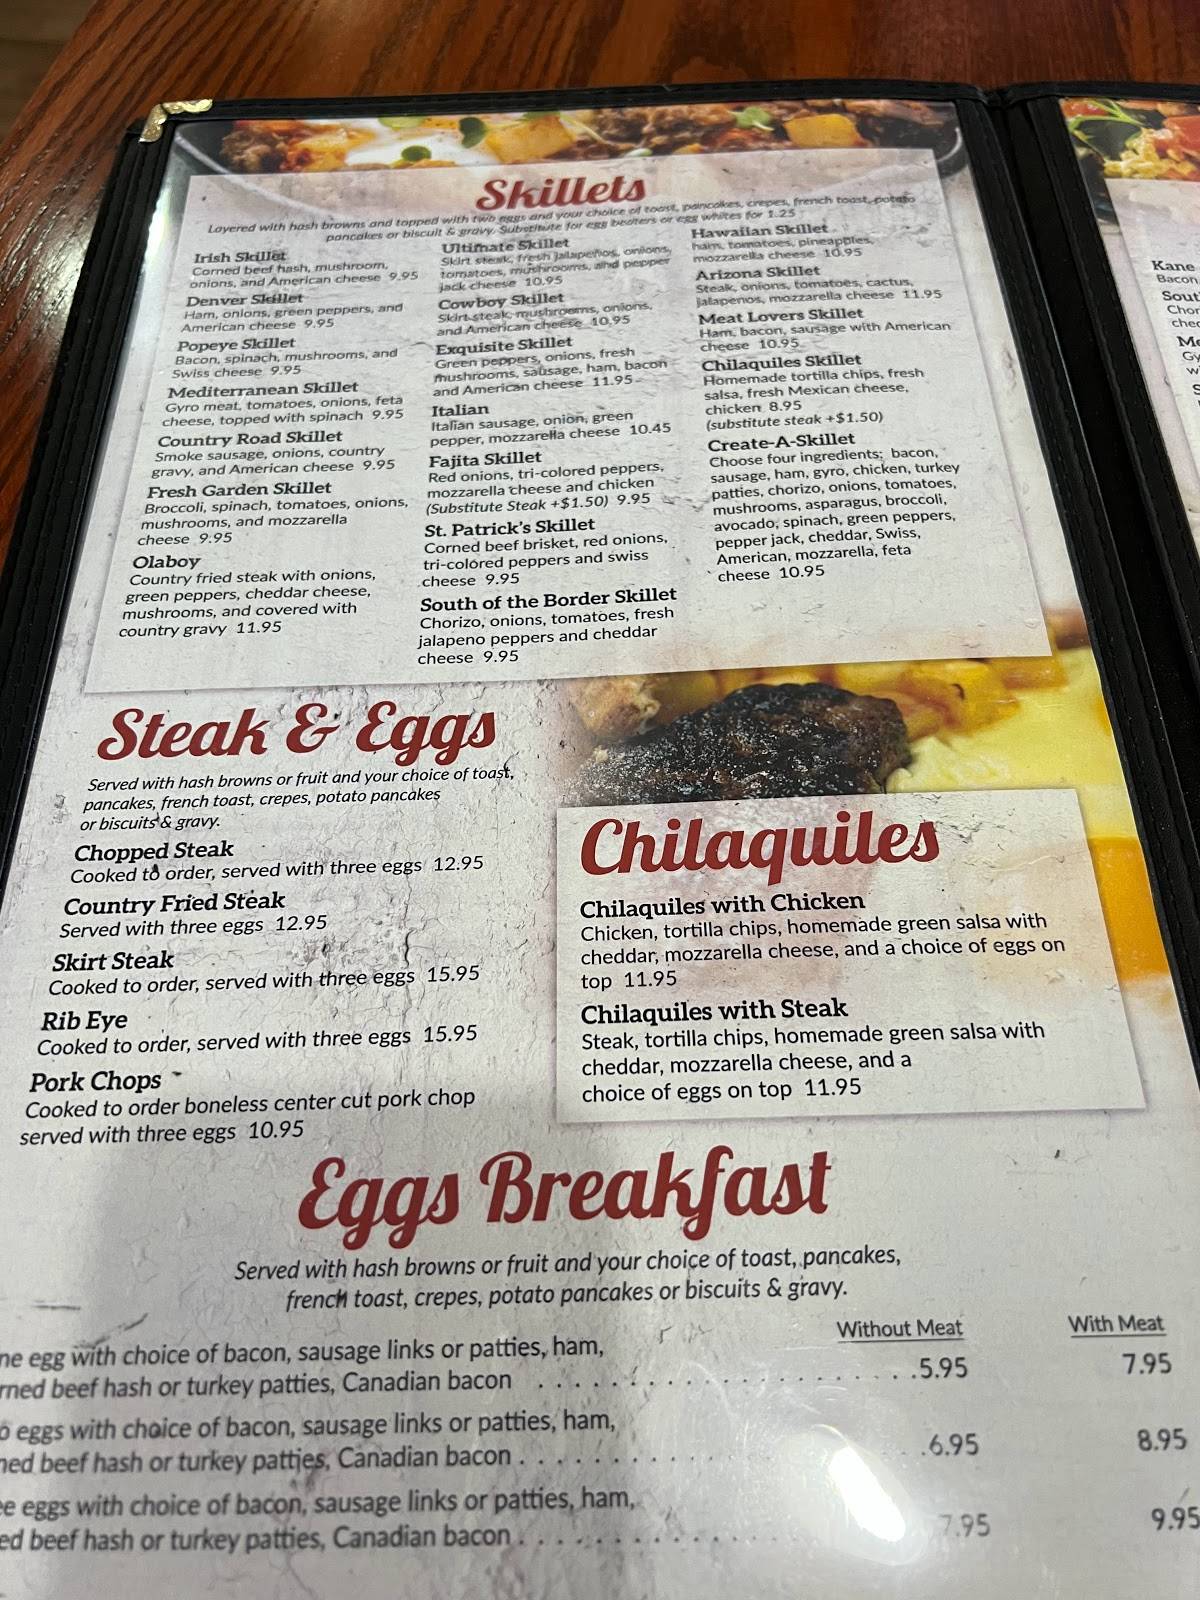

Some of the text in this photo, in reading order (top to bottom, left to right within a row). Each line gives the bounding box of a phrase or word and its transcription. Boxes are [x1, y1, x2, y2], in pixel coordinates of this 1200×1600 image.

[477, 176, 644, 210] Skillets
[691, 223, 828, 238] Hawaiian Skillet
[441, 238, 569, 253] Ultimate Skillet
[194, 250, 287, 263] Irish Skillet
[1151, 260, 1195, 271] Kane
[695, 265, 820, 281] Arizona Skillet
[185, 292, 304, 307] Denver Skillet
[437, 292, 564, 310] Cowboy Skillet
[180, 317, 334, 332] American cheese 9.95
[698, 307, 863, 325] Meat Lovers Skillet
[176, 337, 296, 353] Popeye Skillet
[435, 336, 572, 356] Exquisite Skillet
[174, 347, 398, 365] Bacon, spinach, mushrooms, and
[434, 347, 635, 369] Green peppers, onions, fresh
[701, 353, 861, 371] Chilaquiles Skillet
[171, 364, 301, 378] Swiss cheese 9.95
[167, 381, 359, 398] Mediterranean Skillet
[165, 395, 403, 414] Gyro meat, tomatoes, onions, feta
[431, 403, 489, 417] Italian
[705, 399, 802, 415] chicken 8.95
[706, 411, 883, 431] (substitute steak +$1.50)
[157, 430, 342, 447] Country Road Skillet
[707, 432, 855, 451] Create-A-Skillet
[154, 446, 385, 462] Smoke sausage, onions, country
[429, 451, 542, 469] Fajita Skillet
[428, 463, 664, 482] Red onions, tri-colored peppers,
[710, 461, 959, 484] sausage, ham, gyro, chicken, turkey
[146, 481, 332, 498] Fresh Garden Skillet
[426, 492, 650, 516] (Substitute Steak +$1.50) 9.95
[424, 524, 446, 537] St.
[535, 518, 595, 533] Skillet
[424, 532, 667, 553] Corned beef brisket, red onions,
[132, 554, 201, 570] Olaboy
[716, 544, 911, 565] American, mozzarella, feta
[129, 568, 375, 586] Country fried steak with onions,
[718, 564, 824, 582] cheese 10.95
[420, 587, 677, 611] South of the Border Skillet
[420, 606, 673, 629] Chorizo, onions, tomatoes, fresh
[118, 620, 281, 638] country gravy 11.95
[98, 700, 496, 767] Steak & Eggs
[74, 839, 234, 864] Chopped Steak
[581, 810, 940, 886] Chilaquiles
[64, 890, 285, 916] Country Fried Steak
[579, 892, 865, 919] Chilaquiles with Chicken
[52, 949, 174, 971] Skirt Steak
[581, 997, 848, 1026] Chilaquiles with Steak
[40, 1010, 127, 1033] Rib Eye
[37, 1024, 476, 1055] Cooked to order, served with three eggs 15.95
[29, 1070, 161, 1093] Pork Chops
[582, 1077, 861, 1103] choice of eggs on top 11.95
[298, 1145, 831, 1250] Eggs Breakfast
[836, 1318, 963, 1338] Without Meat
[1067, 1314, 1164, 1332] With Meat
[1122, 1352, 1172, 1374] 7.95
[1137, 1427, 1187, 1451] 8.95
[1151, 1506, 1200, 1530] 9.95
